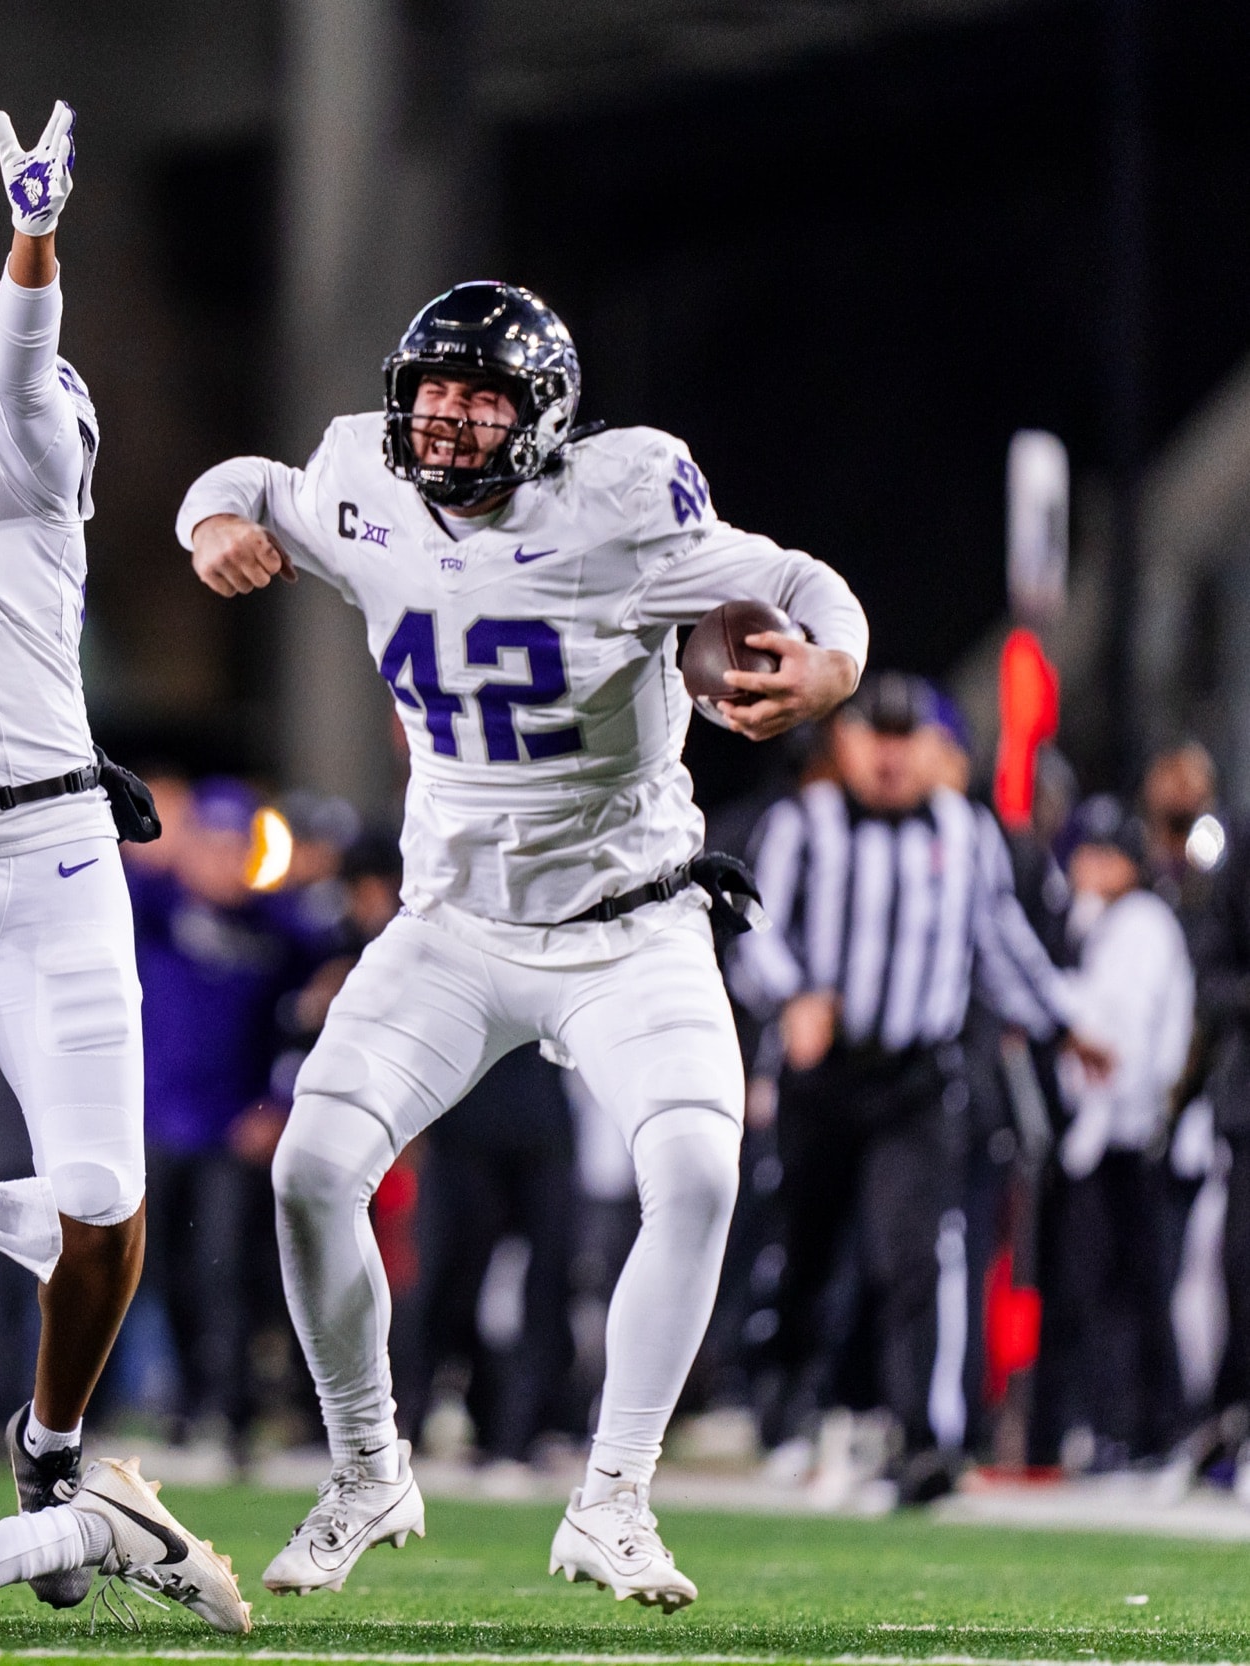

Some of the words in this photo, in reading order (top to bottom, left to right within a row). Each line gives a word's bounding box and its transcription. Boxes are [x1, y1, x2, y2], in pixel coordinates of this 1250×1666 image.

[338, 501, 358, 540] C
[360, 520, 391, 547] XII
[440, 558, 463, 571] TCU
[379, 606, 587, 765] 42
